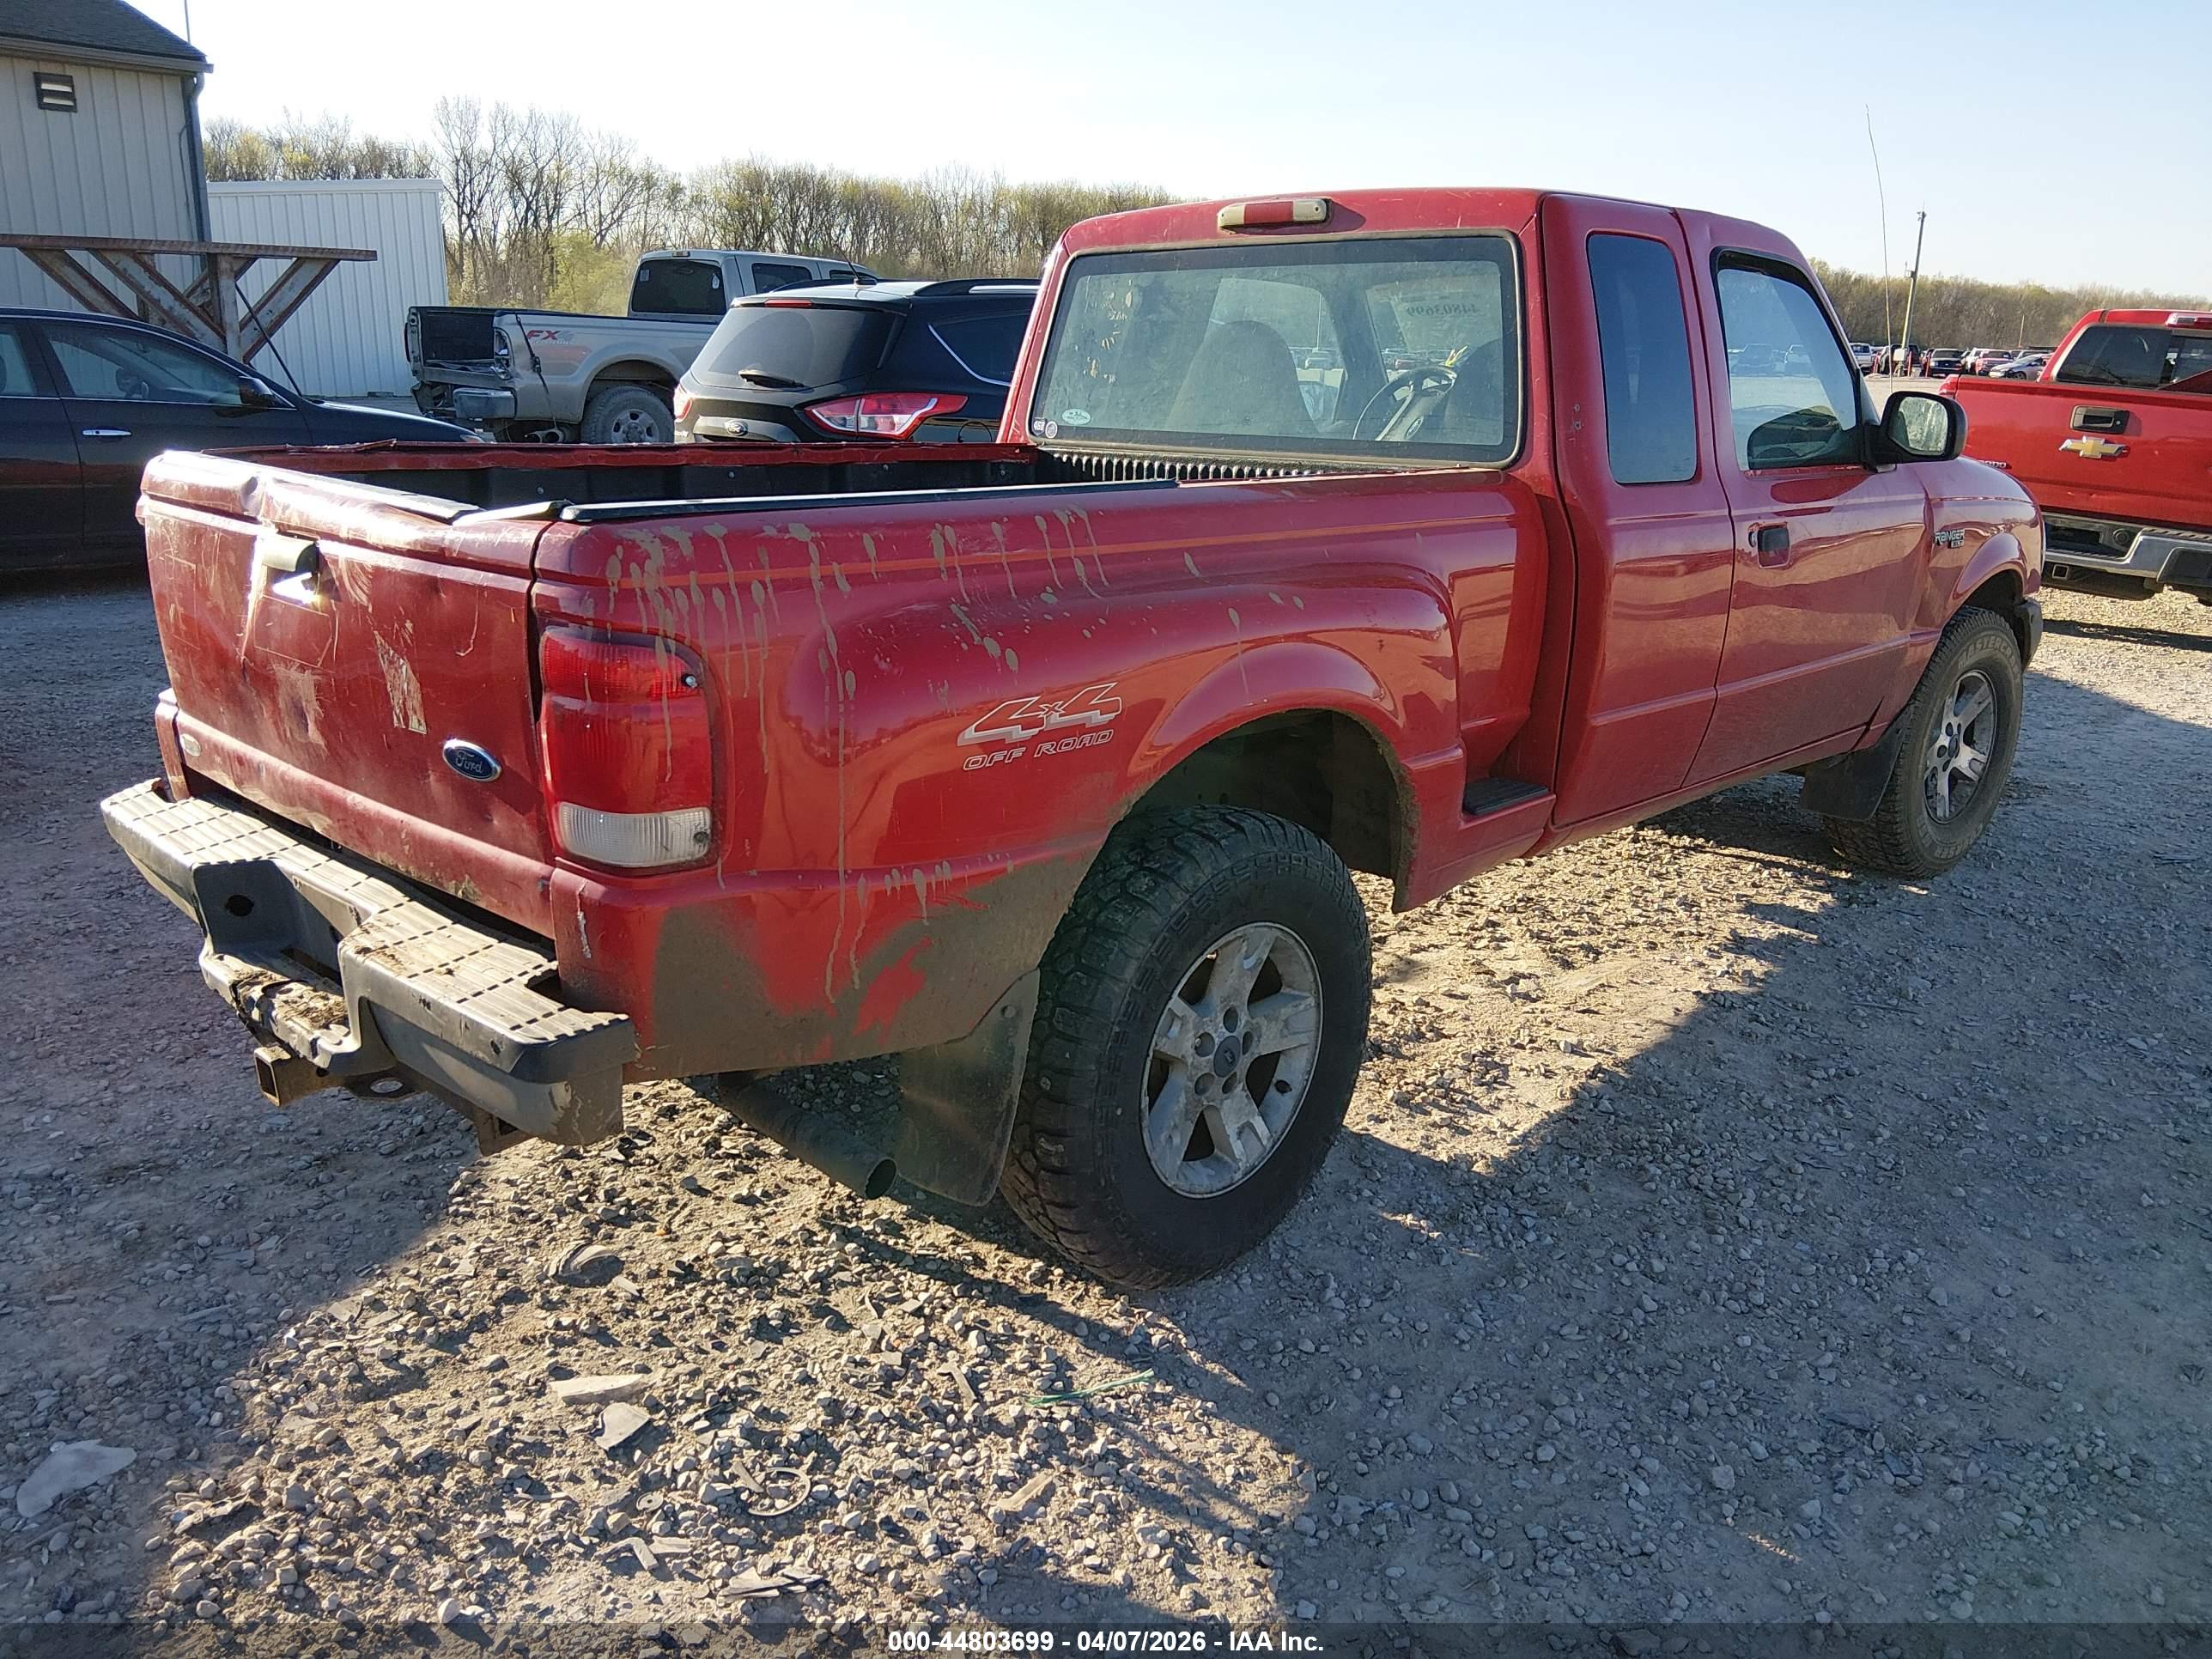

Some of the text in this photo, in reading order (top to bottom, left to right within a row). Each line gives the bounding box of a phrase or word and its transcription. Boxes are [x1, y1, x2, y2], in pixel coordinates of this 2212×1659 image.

[957, 681, 1122, 747] 4x4
[962, 729, 1115, 771] OFF ROAD
